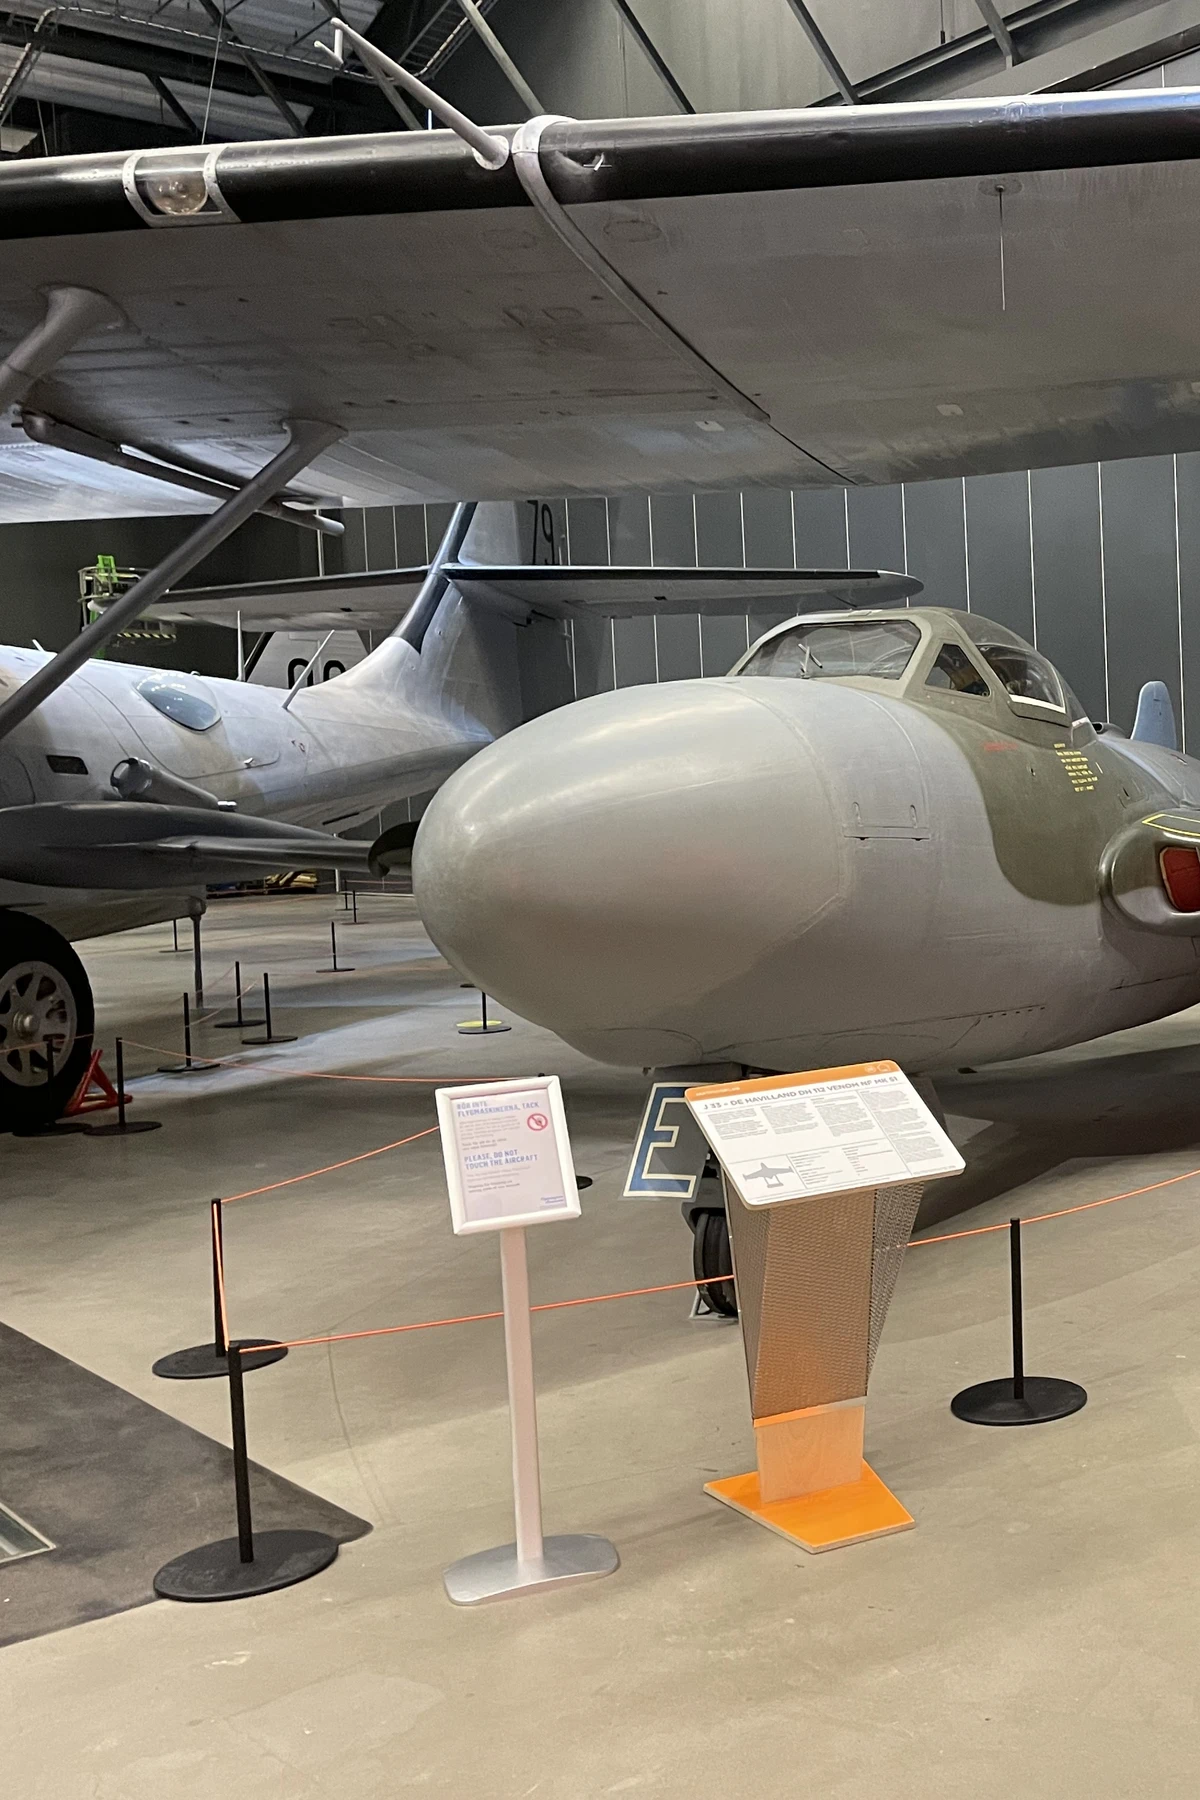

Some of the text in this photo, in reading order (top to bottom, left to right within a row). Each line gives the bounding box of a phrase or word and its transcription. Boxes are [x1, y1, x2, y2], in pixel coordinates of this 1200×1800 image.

[730, 1098, 744, 1106] DE
[744, 1090, 797, 1104] HAVILLAND
[798, 1089, 813, 1097] DH
[813, 1086, 826, 1094] 112
[826, 1083, 860, 1091] VENOM
[860, 1079, 873, 1087] NF
[873, 1077, 888, 1085] MK
[522, 1101, 540, 1109] TACK
[623, 1082, 718, 1198] E
[465, 1154, 538, 1170] TOUCH THE AIRCRAFT
[493, 1151, 503, 1159] DO
